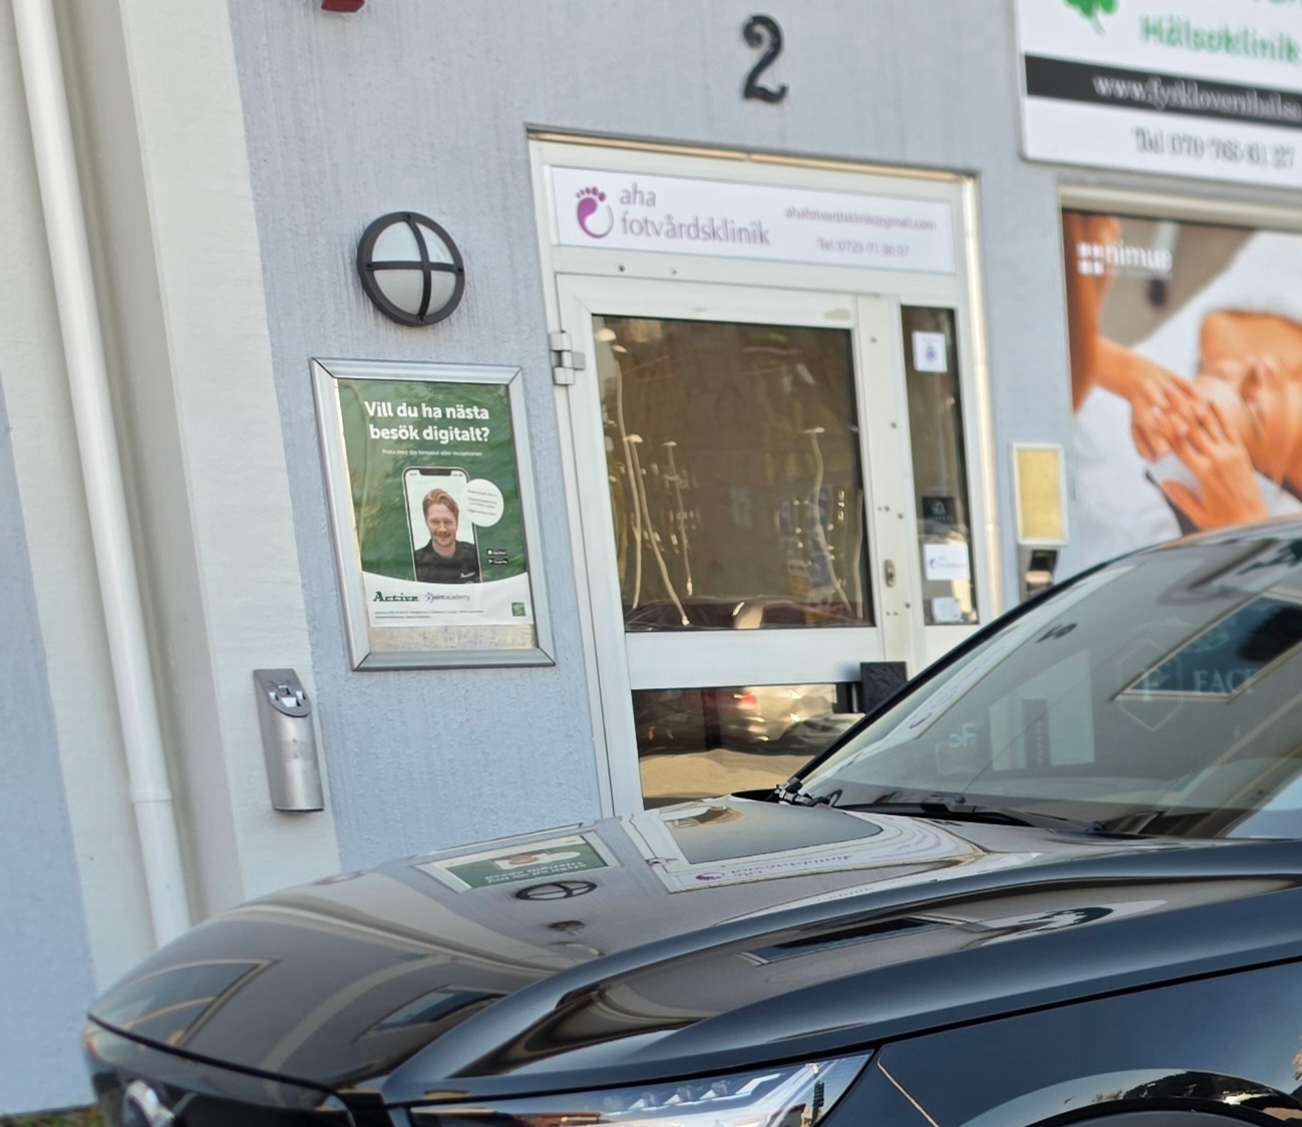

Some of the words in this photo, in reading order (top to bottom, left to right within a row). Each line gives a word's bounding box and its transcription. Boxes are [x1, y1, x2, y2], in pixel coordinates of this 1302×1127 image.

[1140, 15, 1301, 64] Hälsoklinik
[742, 13, 790, 104] 2
[618, 182, 657, 207] aha
[620, 210, 771, 246] fotvårdsklinik
[364, 401, 394, 418] Vill
[396, 403, 418, 419] du
[421, 403, 442, 419] ha
[446, 405, 490, 420] nästa
[368, 424, 420, 441] besök
[422, 426, 490, 444] digitalt?
[372, 591, 420, 602] Active
